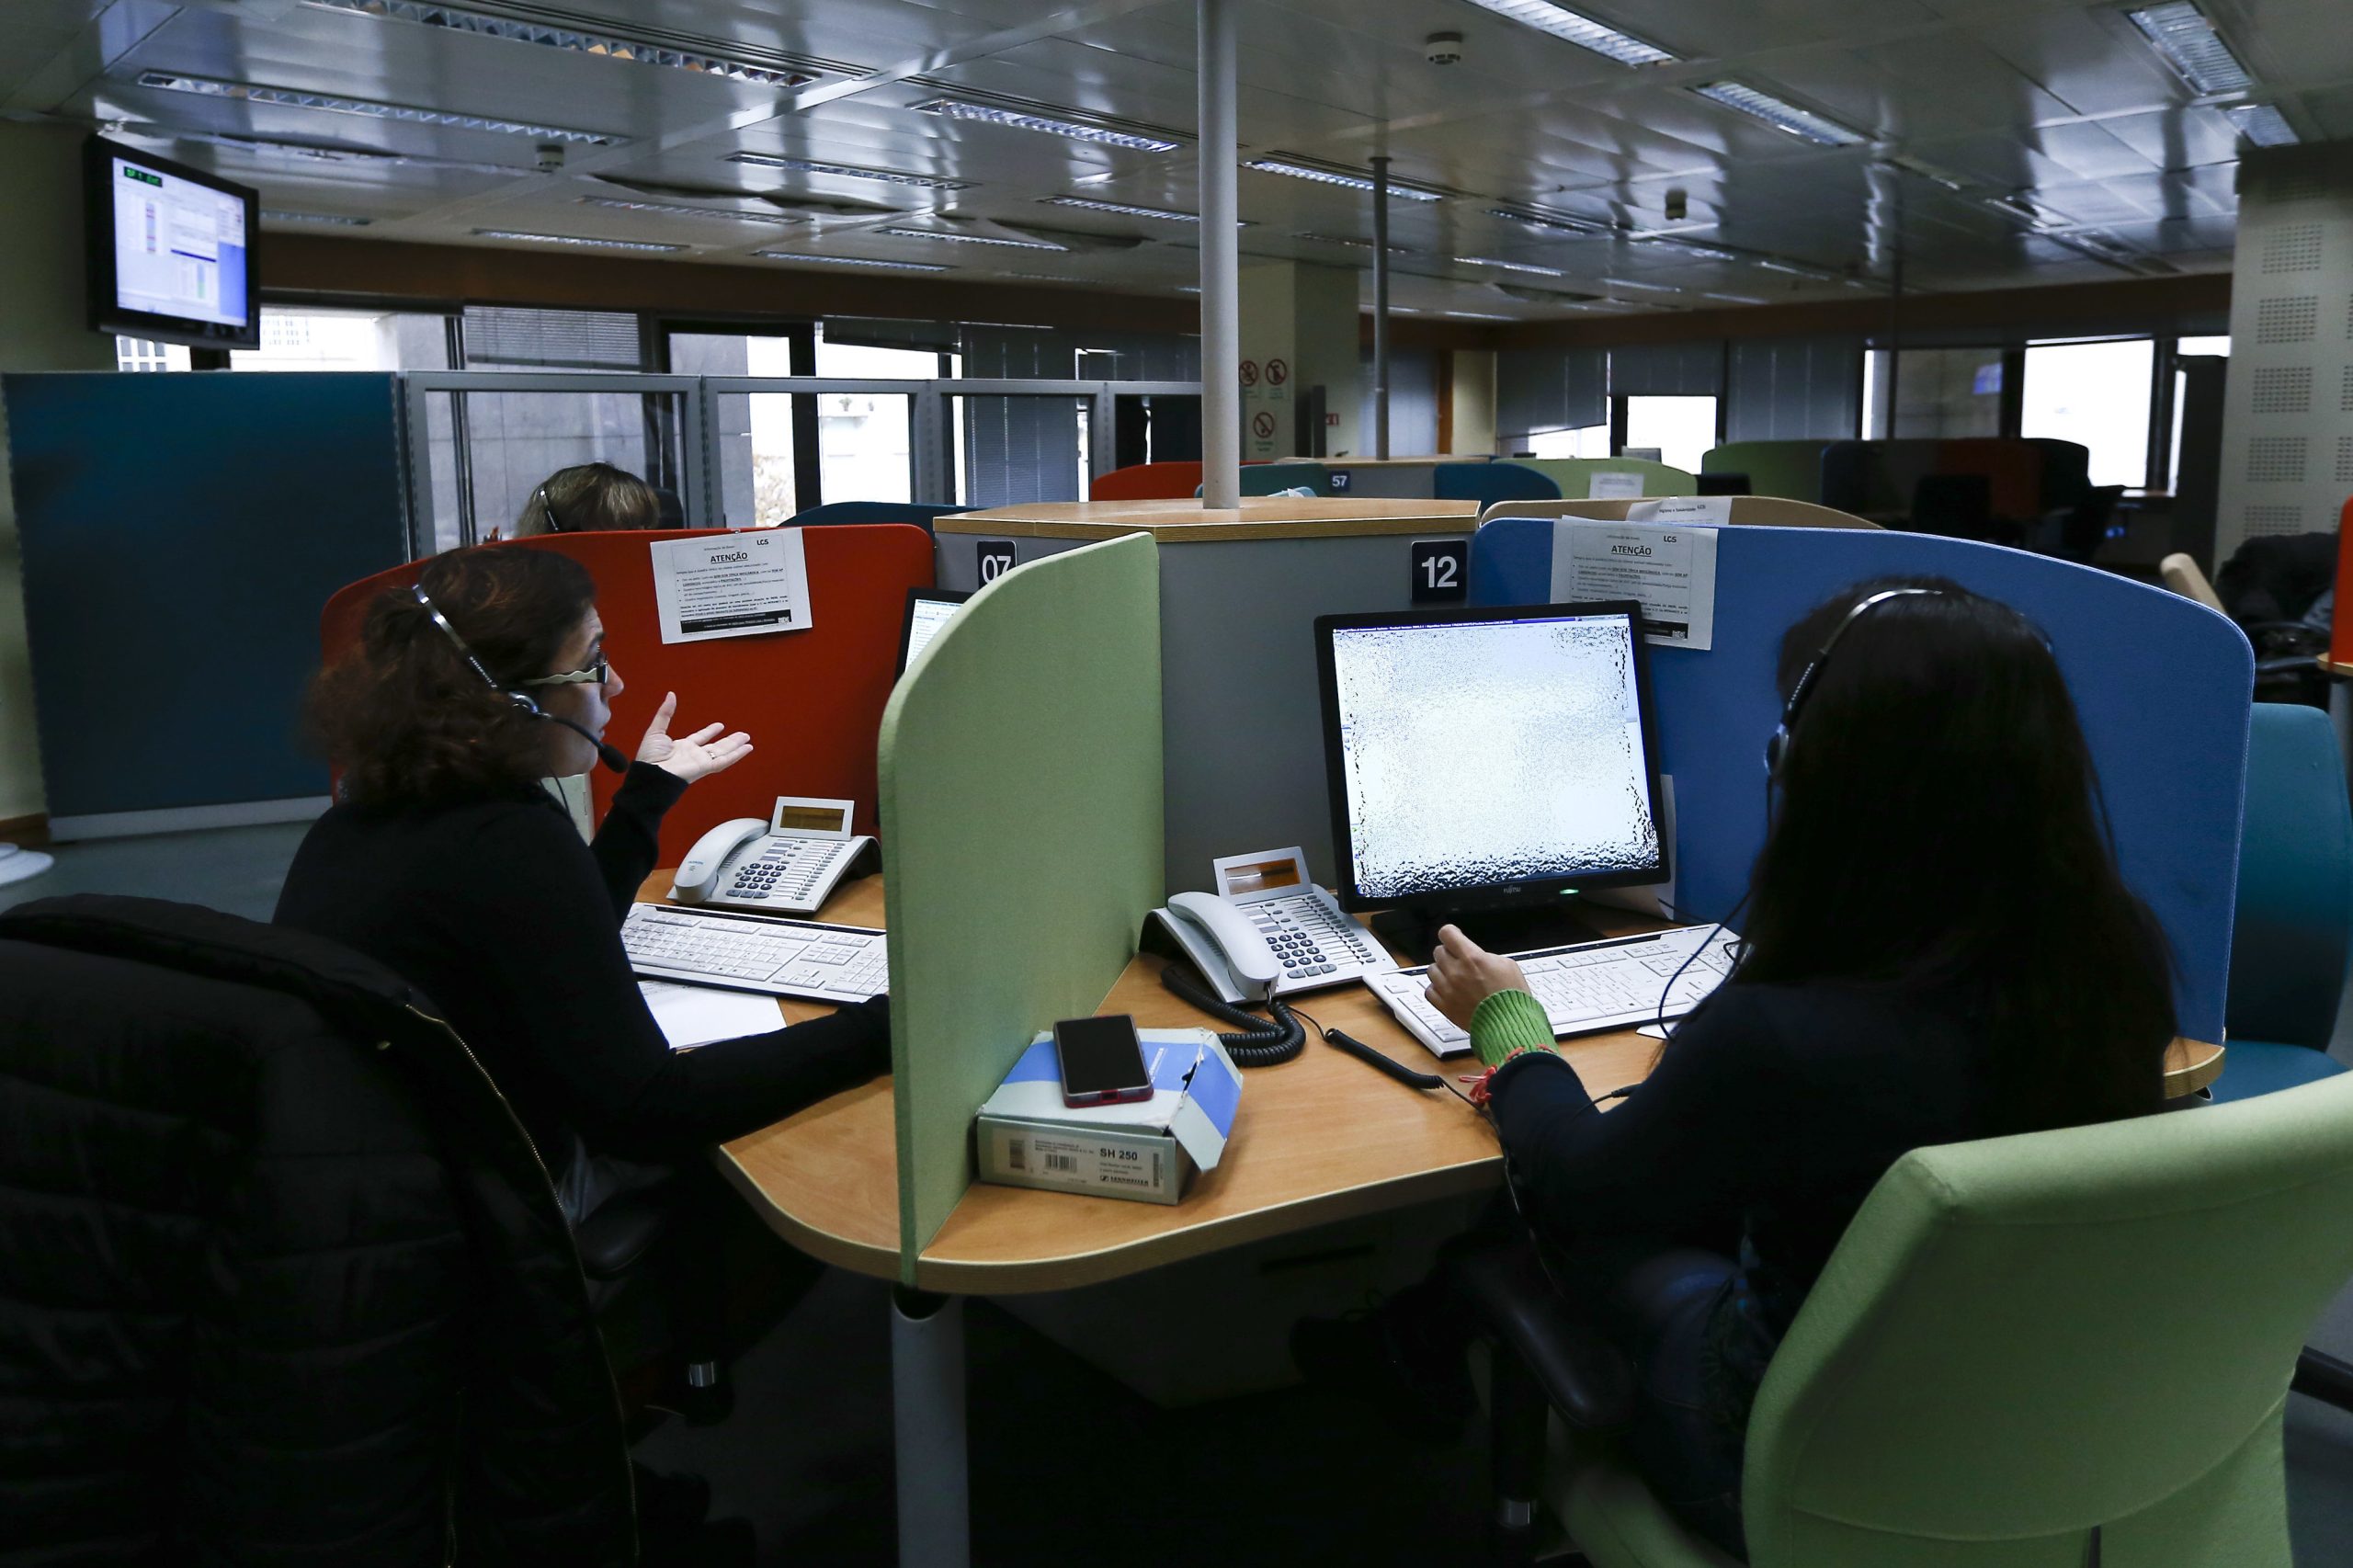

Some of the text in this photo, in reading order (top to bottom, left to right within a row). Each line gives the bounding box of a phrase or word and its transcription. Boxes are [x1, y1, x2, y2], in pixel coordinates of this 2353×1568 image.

[1332, 475, 1347, 487] 57
[1664, 535, 1677, 543] LCS
[1611, 545, 1652, 557] ATENÇÃO
[710, 552, 748, 563] ATENÇÃO
[983, 555, 1011, 584] 07
[1422, 556, 1457, 587] 12
[1100, 1148, 1138, 1161] SH 250
